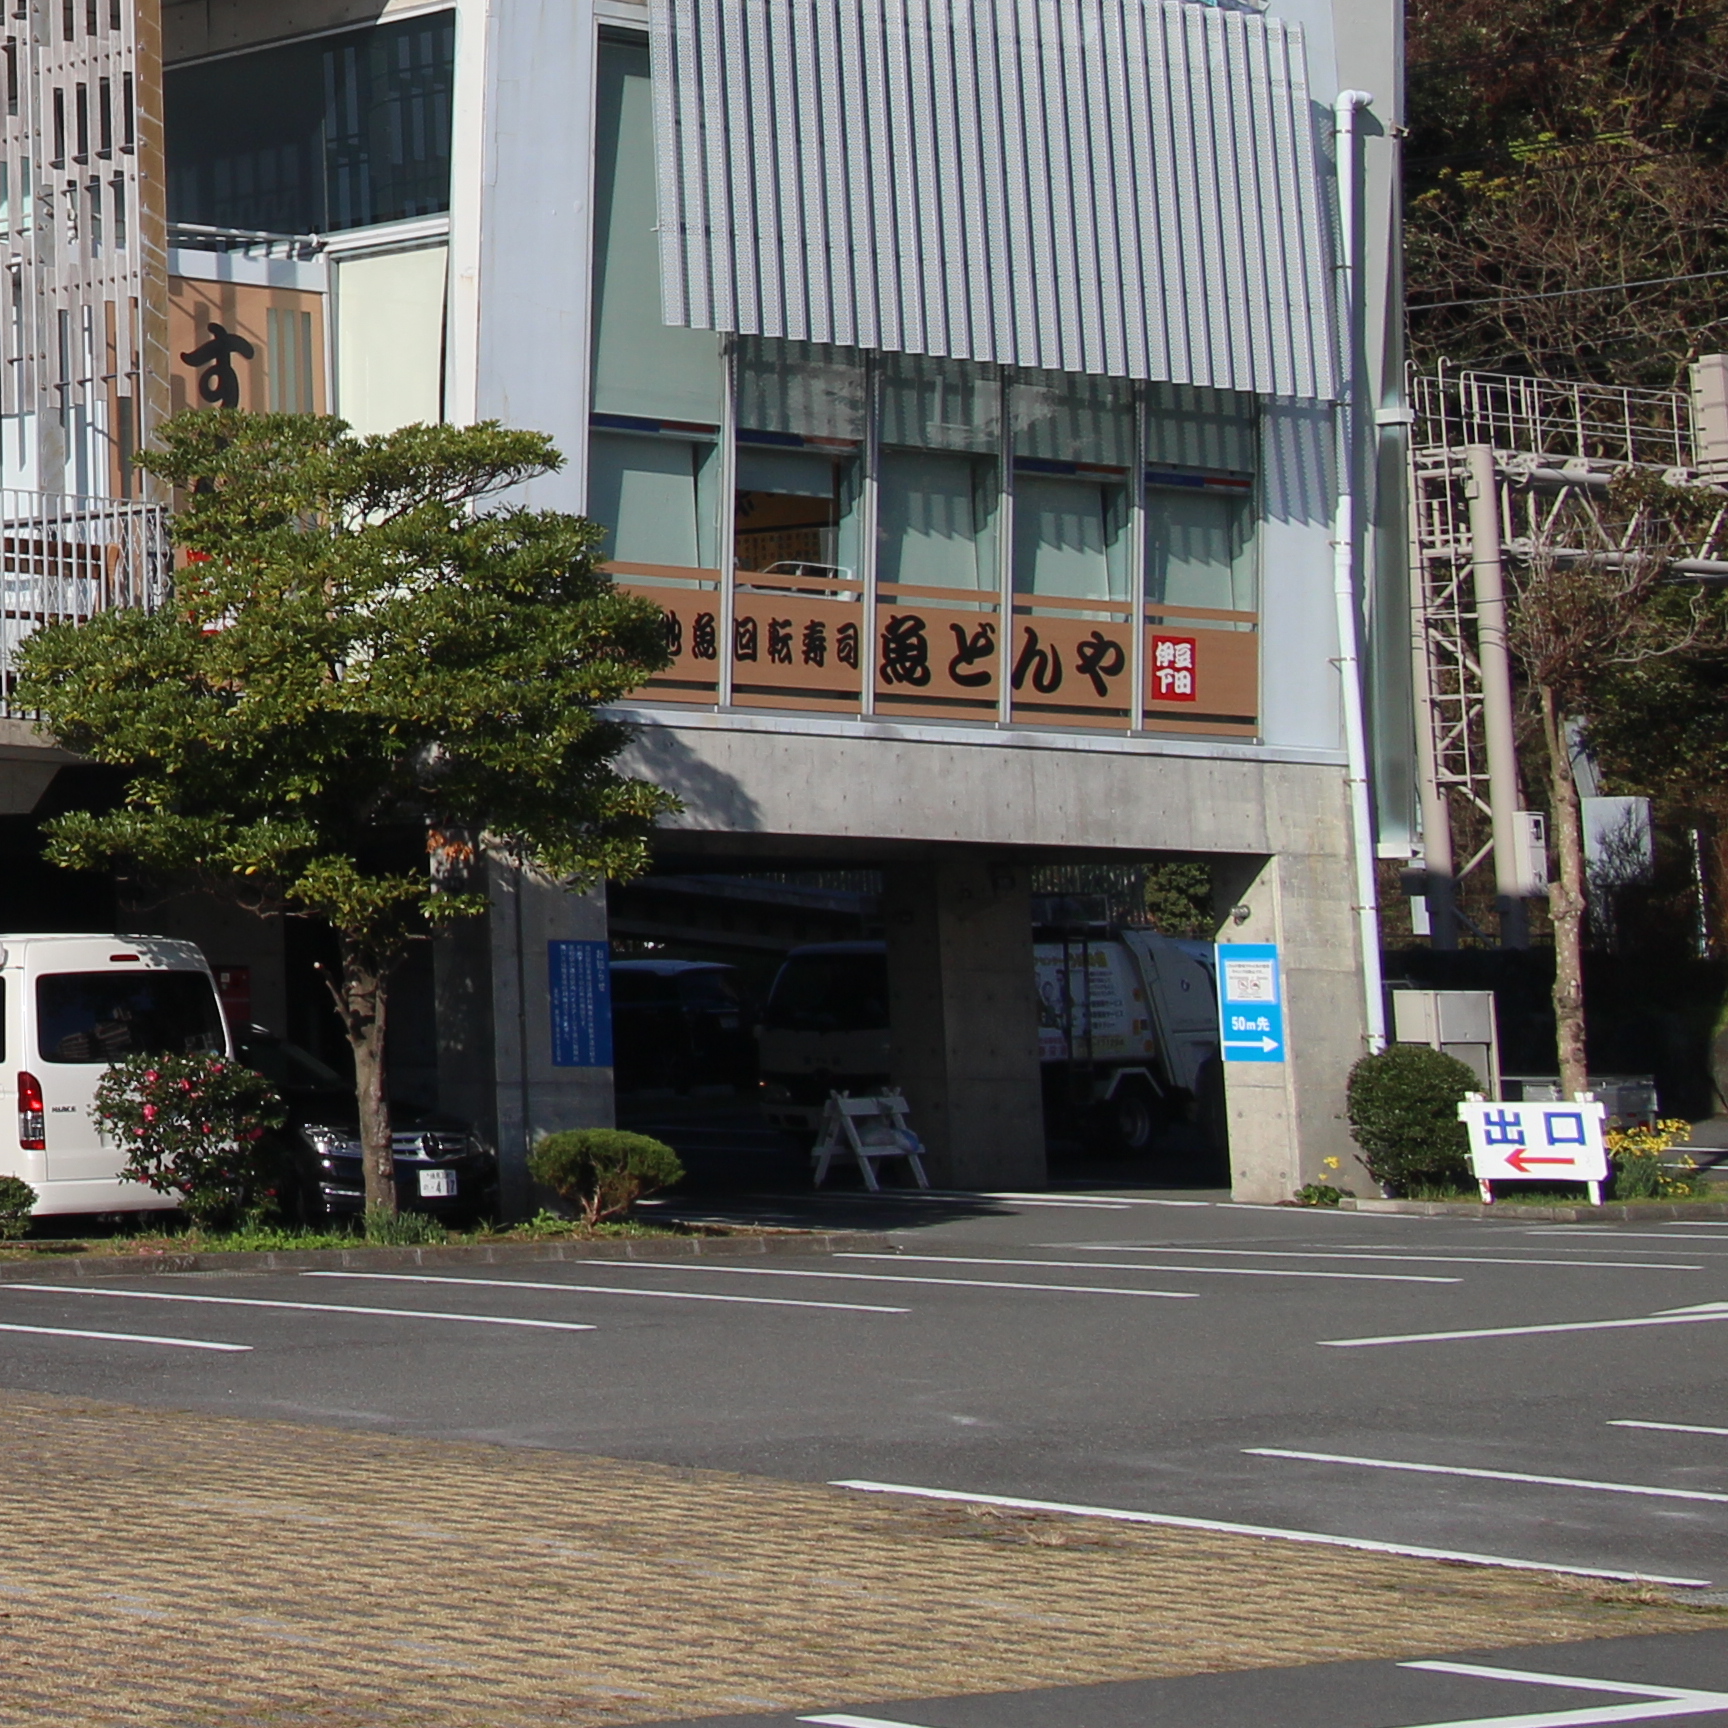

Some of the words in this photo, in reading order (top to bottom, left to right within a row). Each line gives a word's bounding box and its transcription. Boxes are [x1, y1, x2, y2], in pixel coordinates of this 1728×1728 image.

[879, 614, 1126, 697] 魚どんや
[1155, 640, 1193, 669] 伊豆
[1155, 669, 1192, 695] 下田
[1231, 1015, 1271, 1032] 50m先
[1482, 1108, 1588, 1146] 出口
